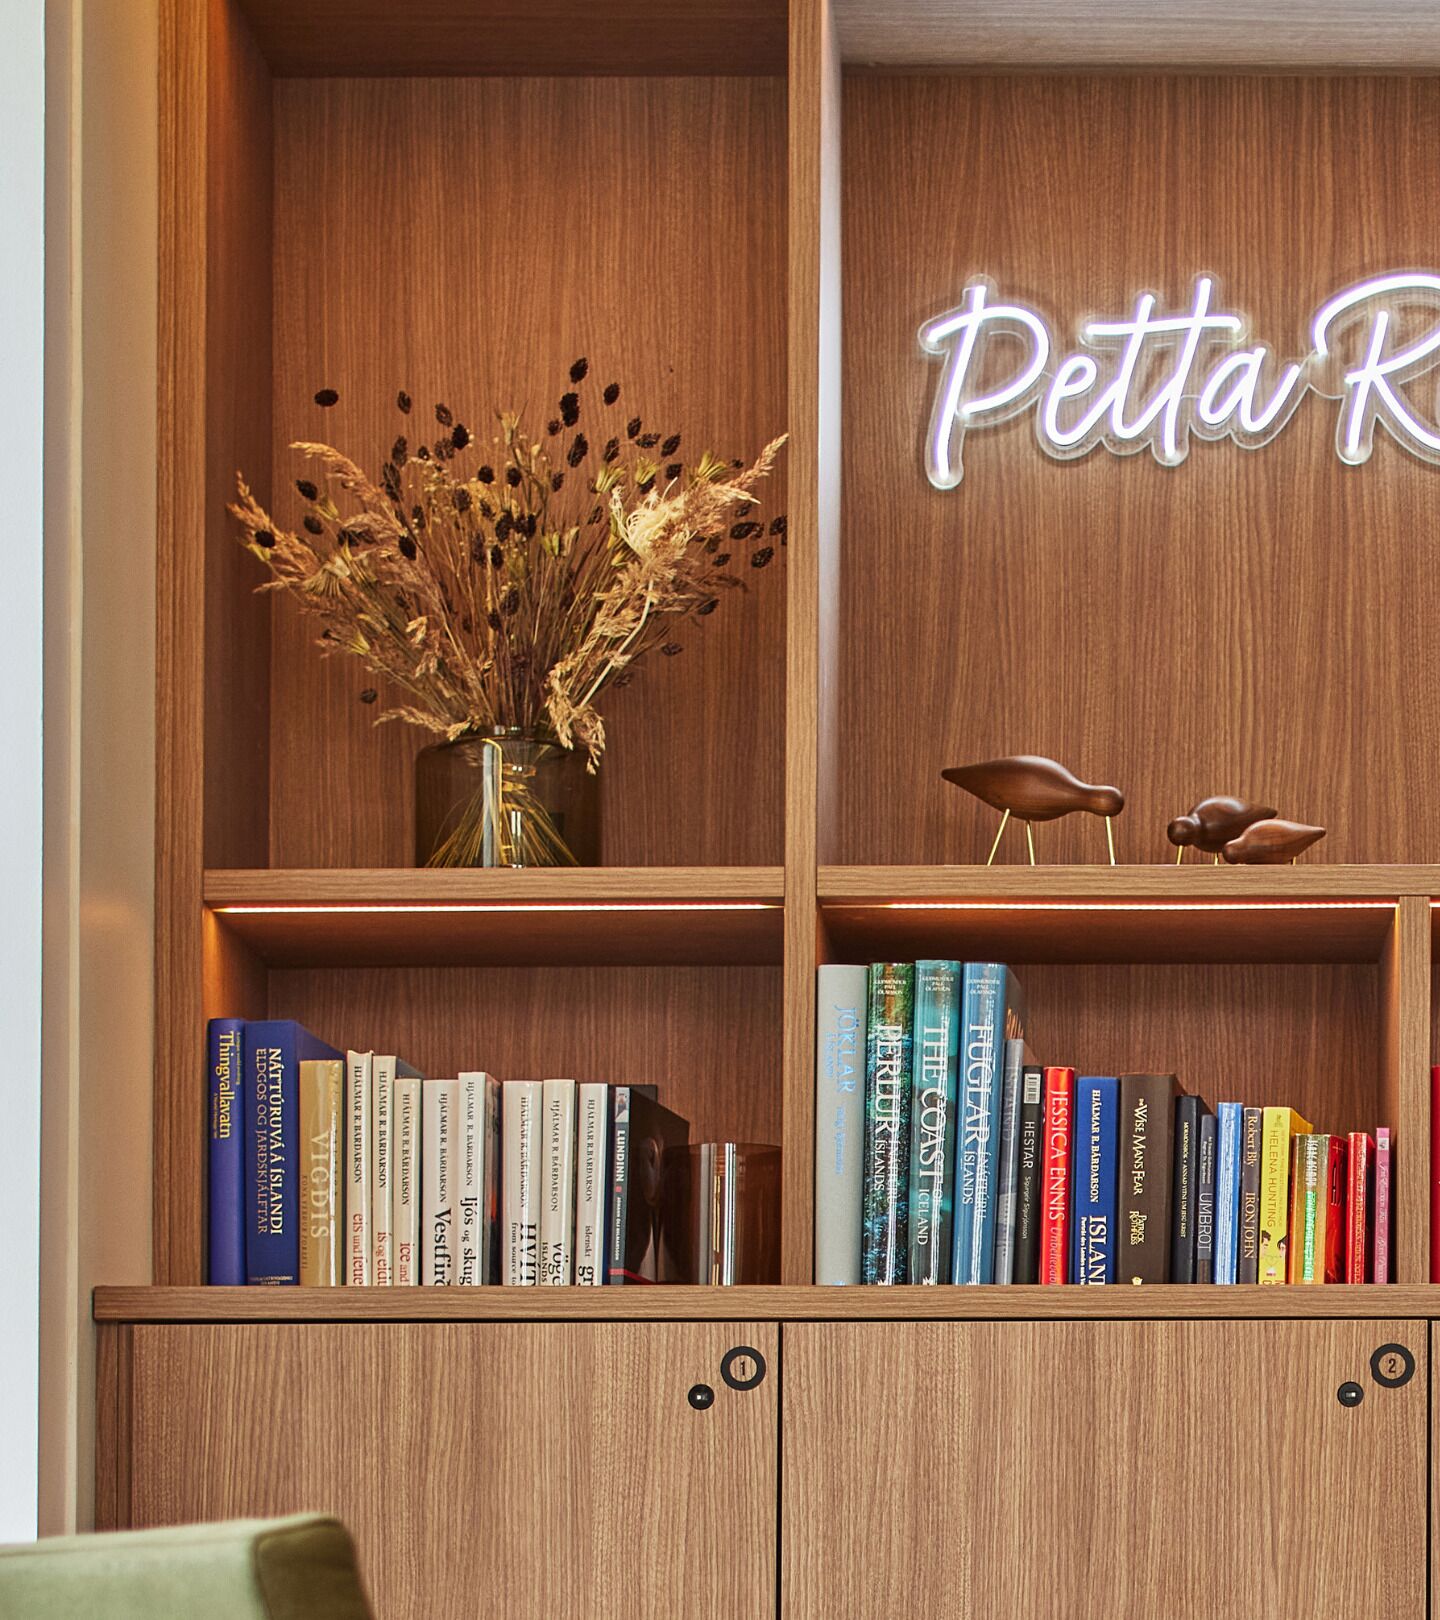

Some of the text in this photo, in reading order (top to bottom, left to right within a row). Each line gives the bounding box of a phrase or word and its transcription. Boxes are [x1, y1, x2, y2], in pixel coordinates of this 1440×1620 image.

[256, 1049, 267, 1100] ELDGOS
[834, 1005, 860, 1094] JÖKLAR
[922, 1024, 950, 1082] THE
[216, 1031, 235, 1138] Thingvallavatn
[874, 1024, 903, 1134] PERLUR
[963, 1024, 994, 1145] FUGLAR
[256, 1104, 267, 1126] OG
[466, 1124, 474, 1133] R.
[918, 1087, 947, 1183] COAST
[1049, 1090, 1068, 1160] JESSICA
[1091, 1089, 1102, 1134] HJÁLMAR
[269, 1048, 285, 1234] NÁTTÚRUVÁ Á ÍSLANDI
[439, 1137, 448, 1146] R.
[551, 1146, 559, 1155] R.
[616, 1130, 625, 1182] LUNDINN
[1023, 1121, 1035, 1169] HESTAR
[1091, 1135, 1099, 1144] R.
[962, 1151, 976, 1205] ÍSLANDS
[1049, 1168, 1066, 1221] ENNIS
[1243, 1116, 1258, 1258] Robert Bly IRON JOHN
[1267, 1130, 1279, 1228] HELENA HUNTING
[460, 1197, 477, 1225] ljós
[462, 1230, 470, 1242] og
[916, 1188, 930, 1245] ICELAND
[1198, 1192, 1213, 1252] UMBROT
[376, 1245, 384, 1257] og
[400, 1242, 415, 1262] ice
[400, 1265, 409, 1282] and
[578, 1266, 595, 1286] gr
[739, 1361, 746, 1376] 1
[1388, 1358, 1397, 1374] 2
